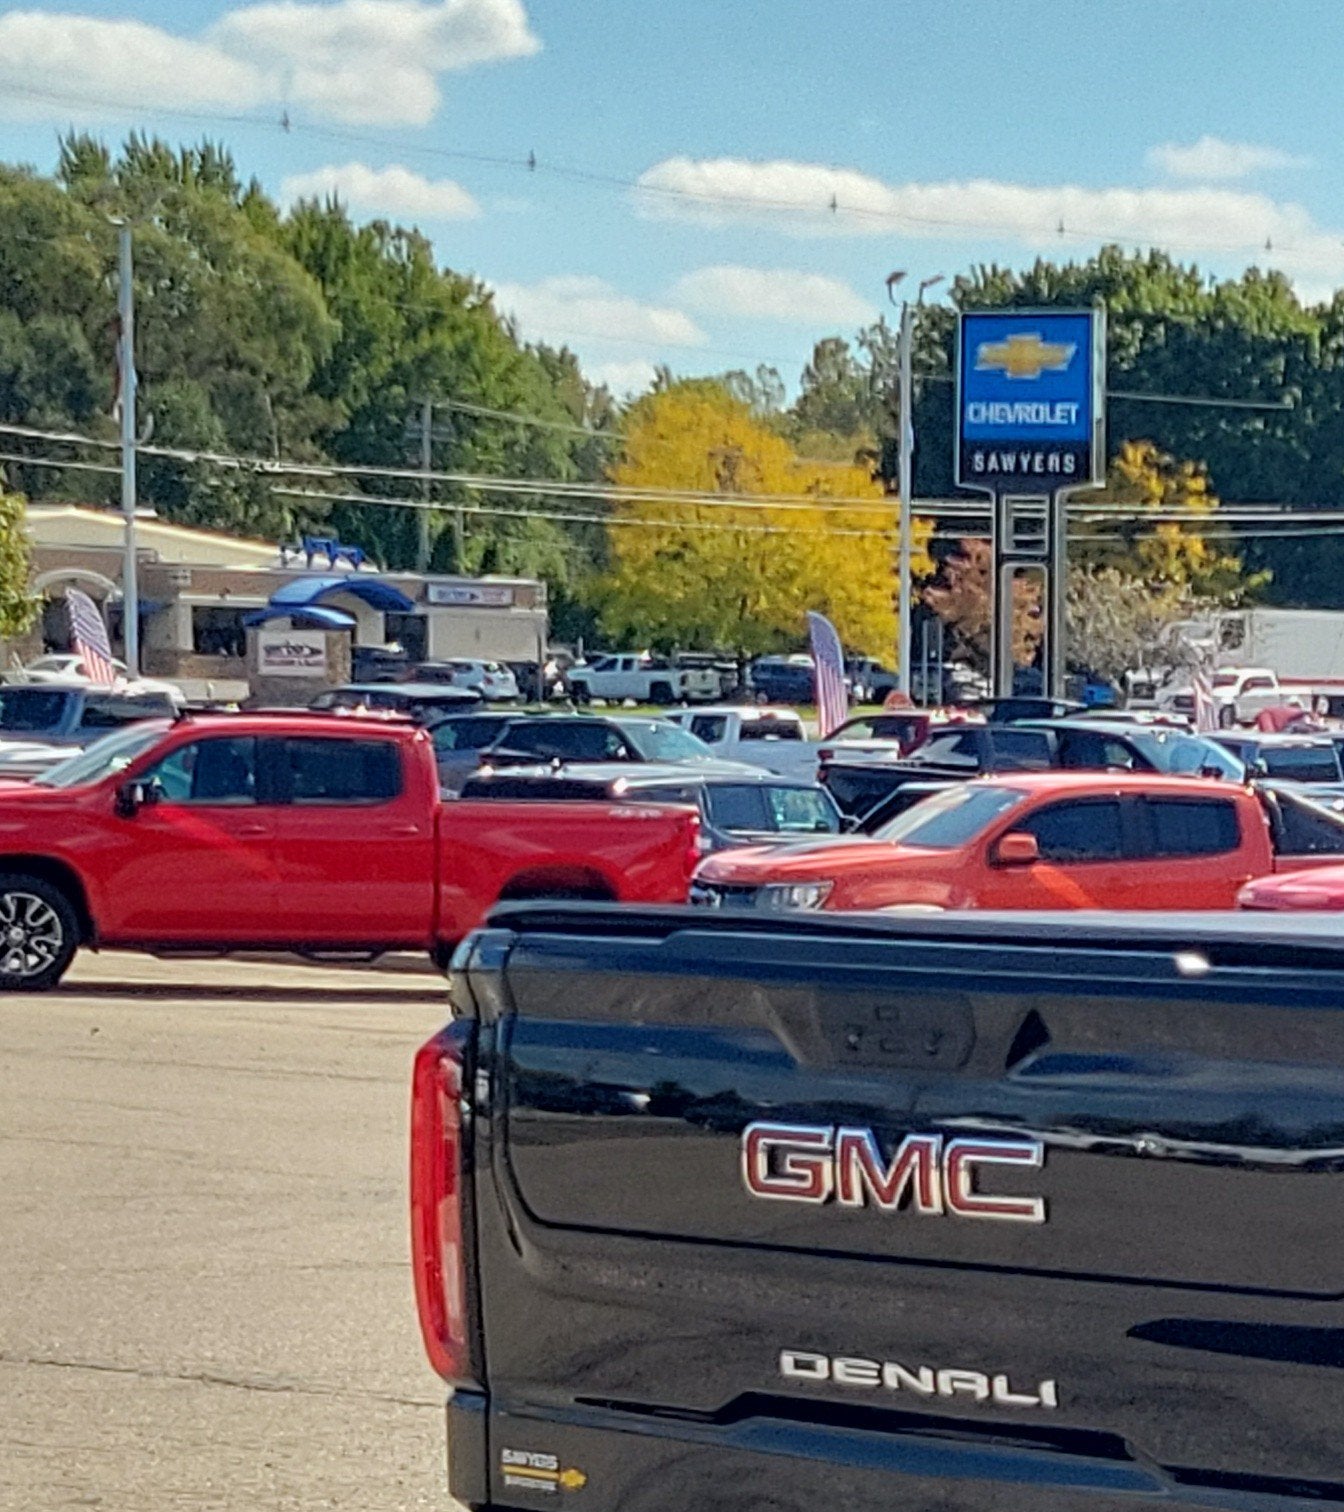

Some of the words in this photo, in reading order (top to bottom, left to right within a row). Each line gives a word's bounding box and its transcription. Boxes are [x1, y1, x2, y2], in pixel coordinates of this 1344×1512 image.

[967, 402, 1079, 425] CHEVROLET
[973, 451, 1076, 474] SAWYERS
[742, 1121, 1046, 1224] GMC
[779, 1349, 1058, 1408] DENALI
